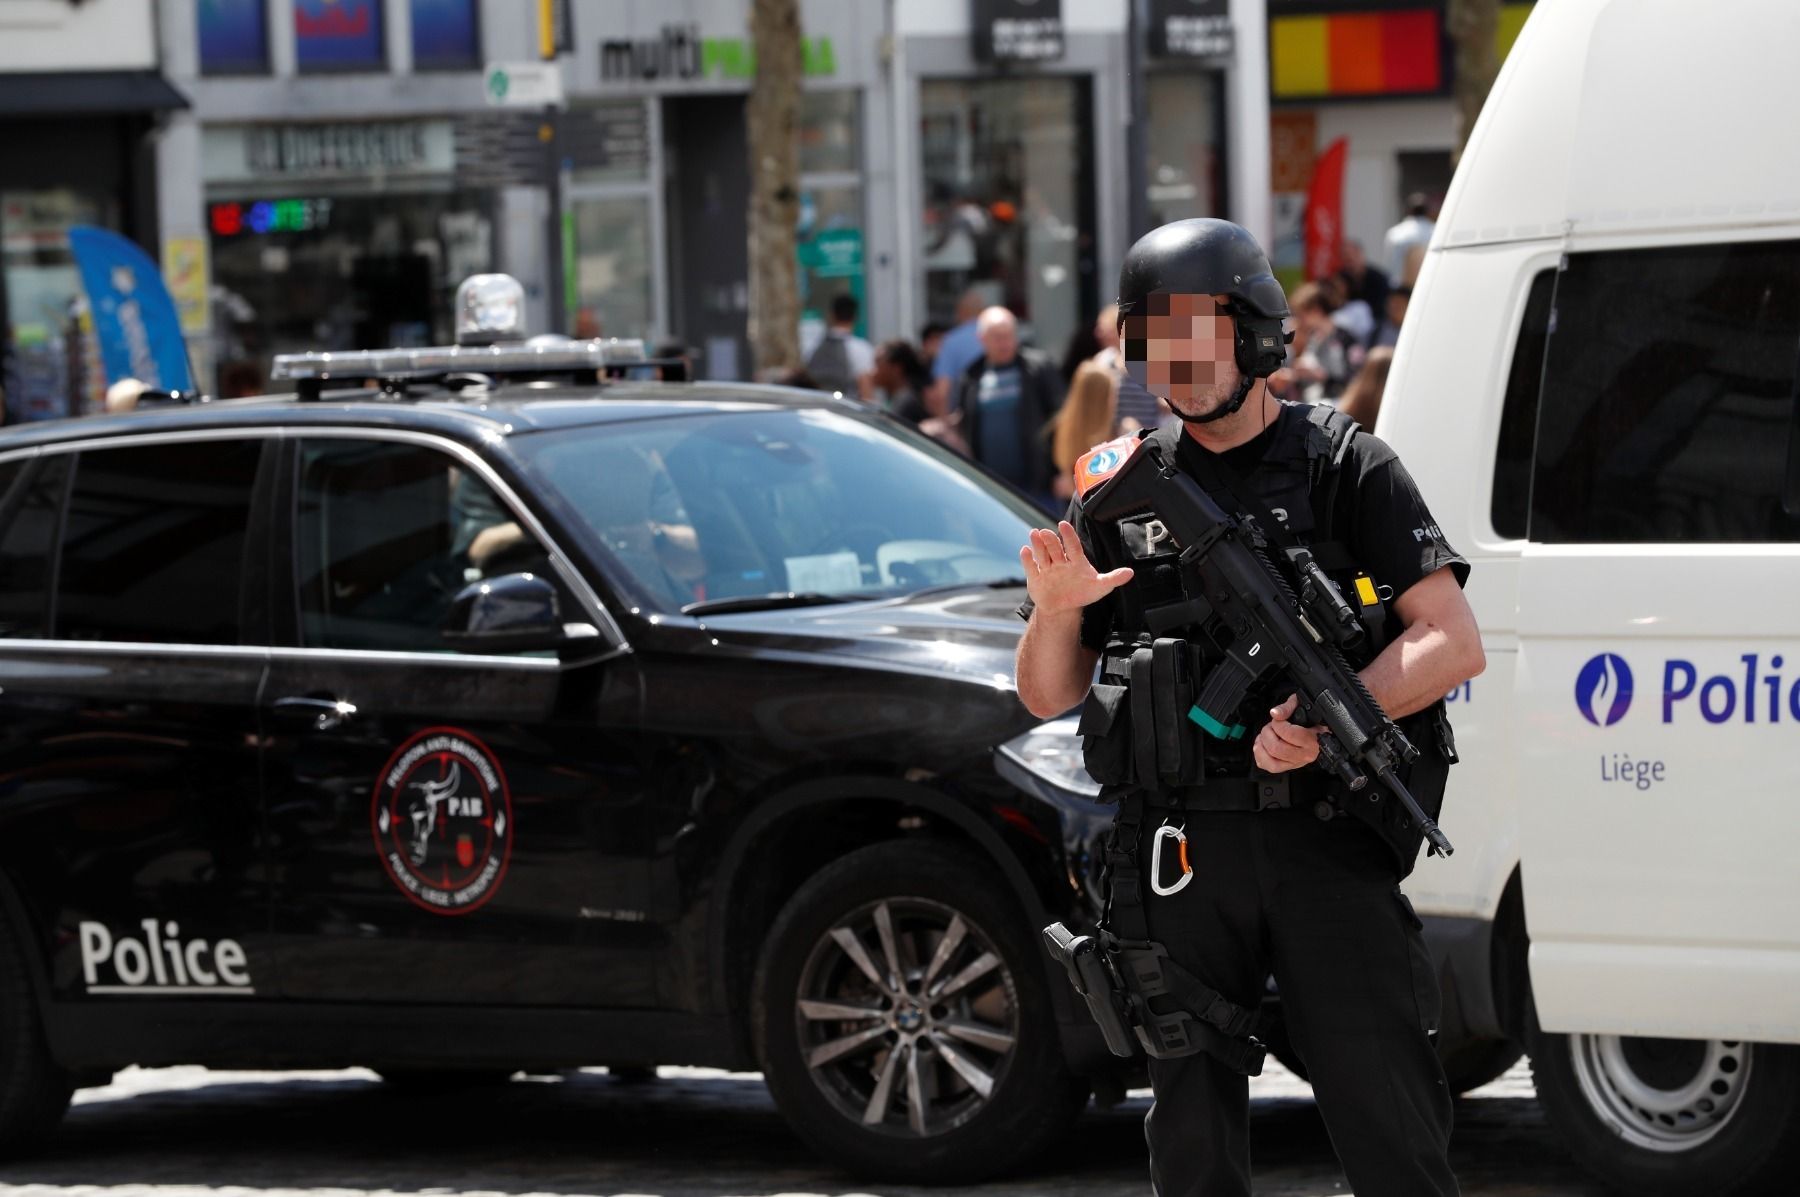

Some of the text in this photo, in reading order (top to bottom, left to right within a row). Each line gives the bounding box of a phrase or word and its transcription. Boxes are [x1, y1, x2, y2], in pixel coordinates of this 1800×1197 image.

[1600, 753, 1666, 790] Liège
[448, 797, 482, 817] PAB
[79, 918, 251, 986] Police
